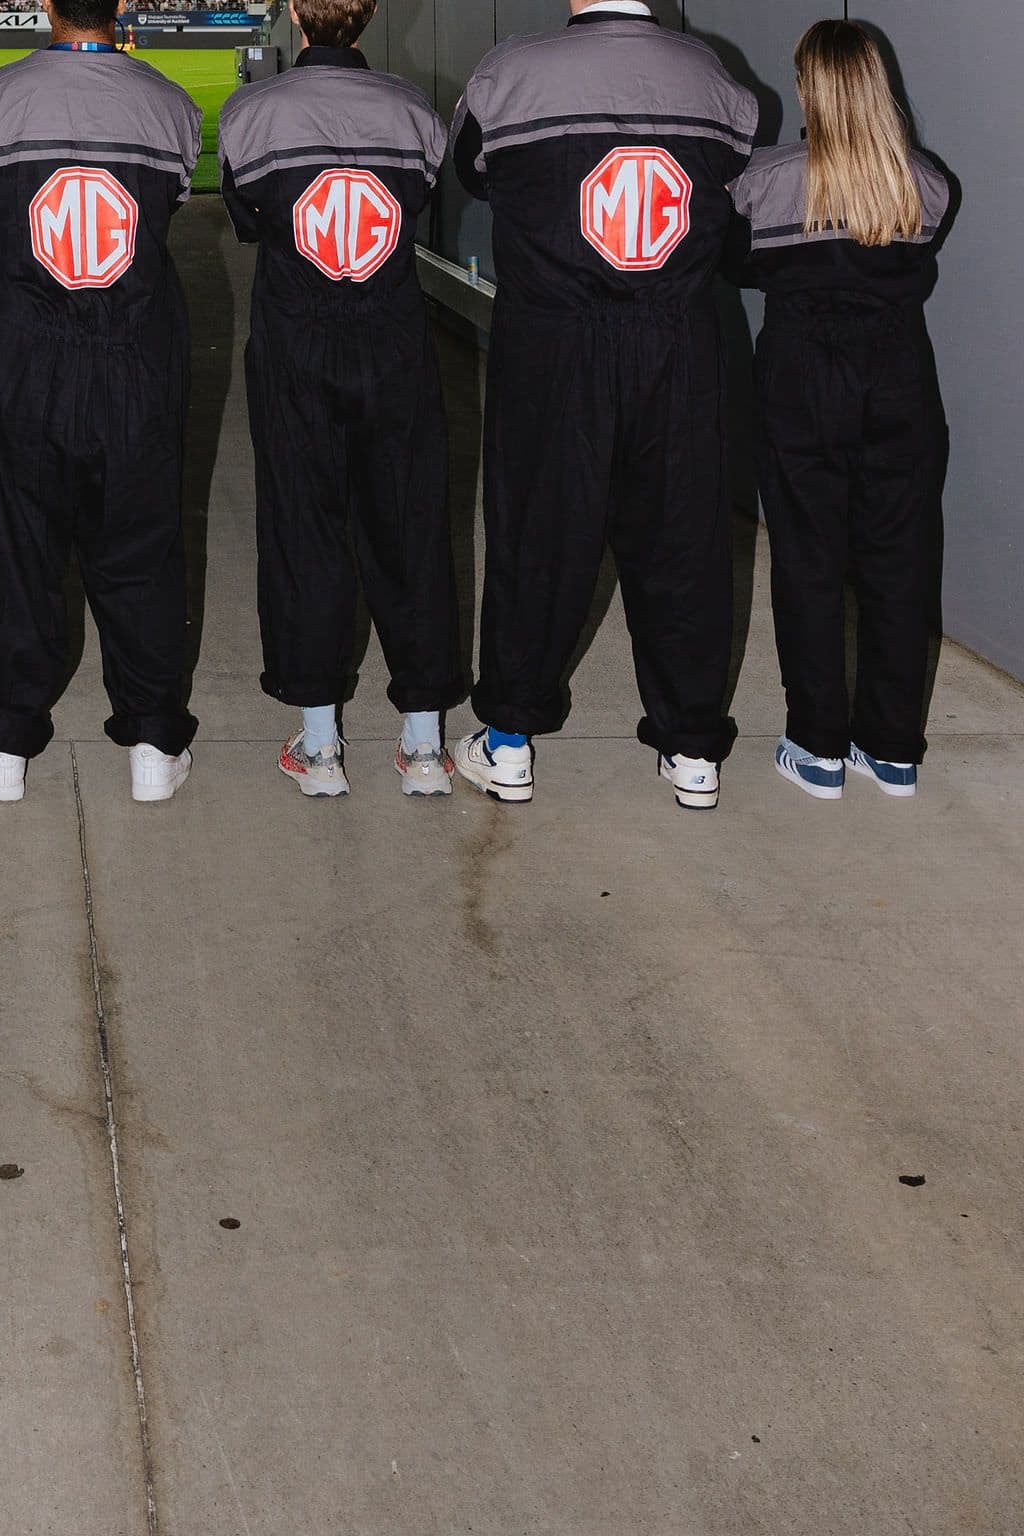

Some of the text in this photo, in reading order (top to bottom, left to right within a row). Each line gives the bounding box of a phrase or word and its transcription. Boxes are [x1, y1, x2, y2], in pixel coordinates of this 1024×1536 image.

[40, 178, 127, 277] MG
[307, 179, 389, 270] MG
[594, 158, 681, 258] MG
